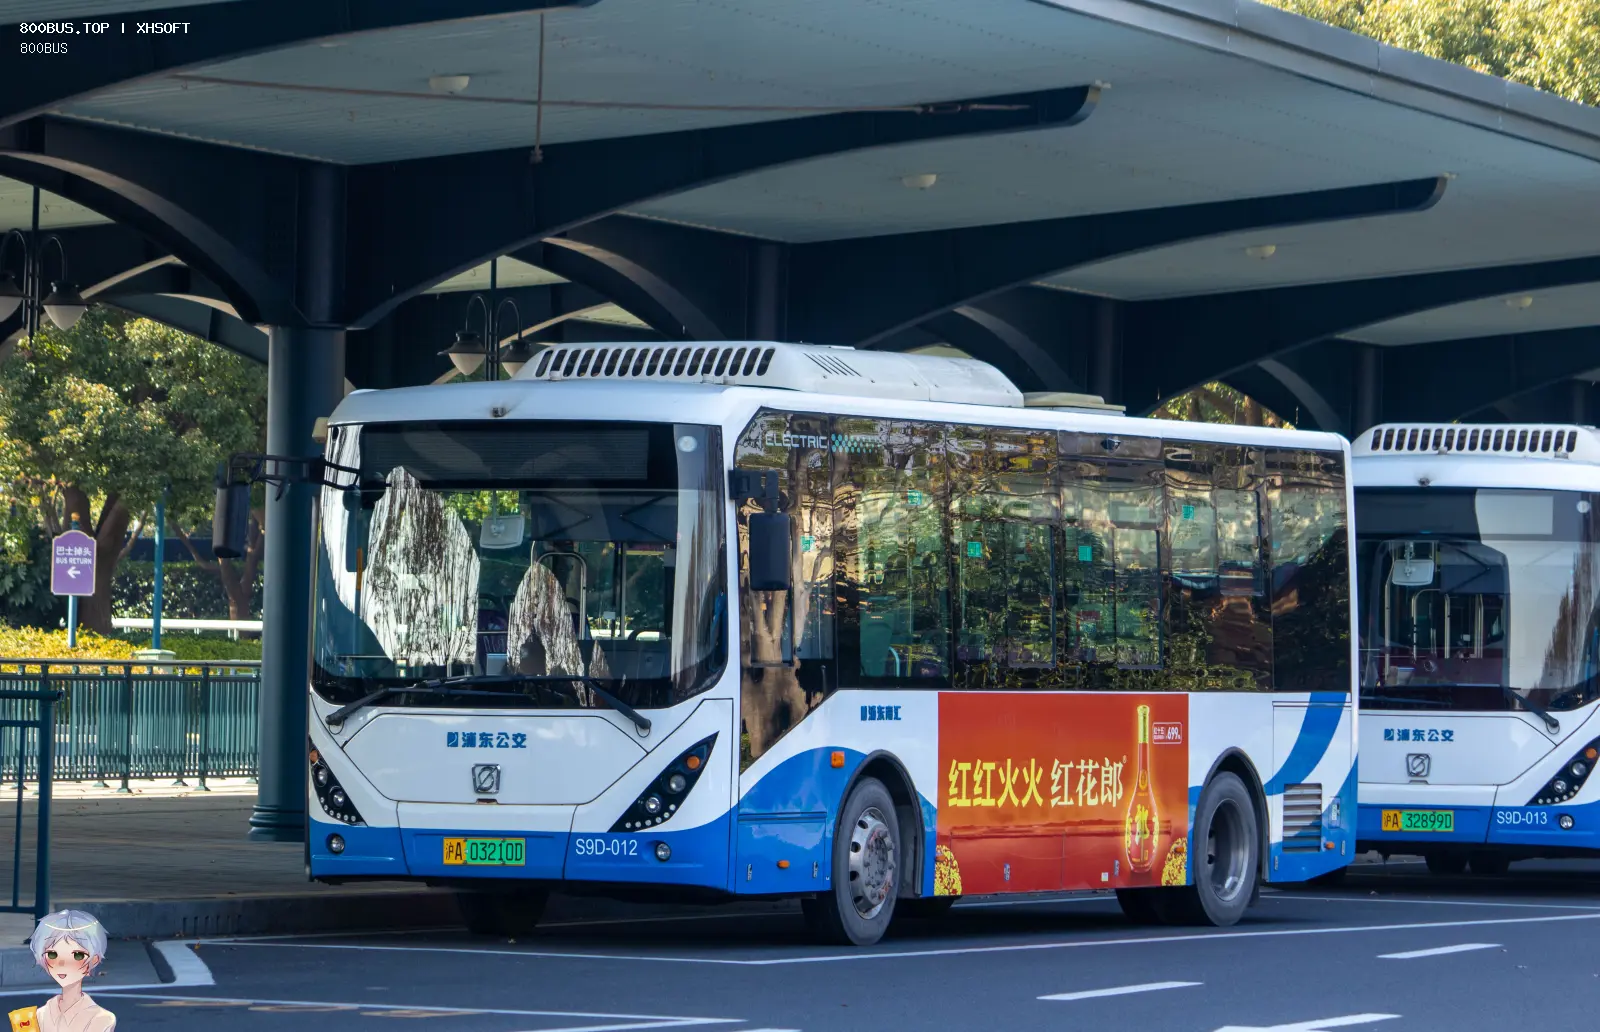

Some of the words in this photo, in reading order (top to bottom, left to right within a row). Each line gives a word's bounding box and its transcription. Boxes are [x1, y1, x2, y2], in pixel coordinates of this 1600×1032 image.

[765, 433, 828, 449] ELECTRIC
[56, 545, 92, 557] 巴士掉头
[56, 557, 68, 565] BUS
[69, 557, 92, 565] RETURN
[461, 731, 527, 749] 浦东公交
[1396, 728, 1454, 742] 浦东公交
[948, 758, 1044, 808] 红红火火
[1050, 756, 1124, 808] 红花郎
[1496, 811, 1548, 825] S9D-013
[575, 838, 638, 856] S9D-012
